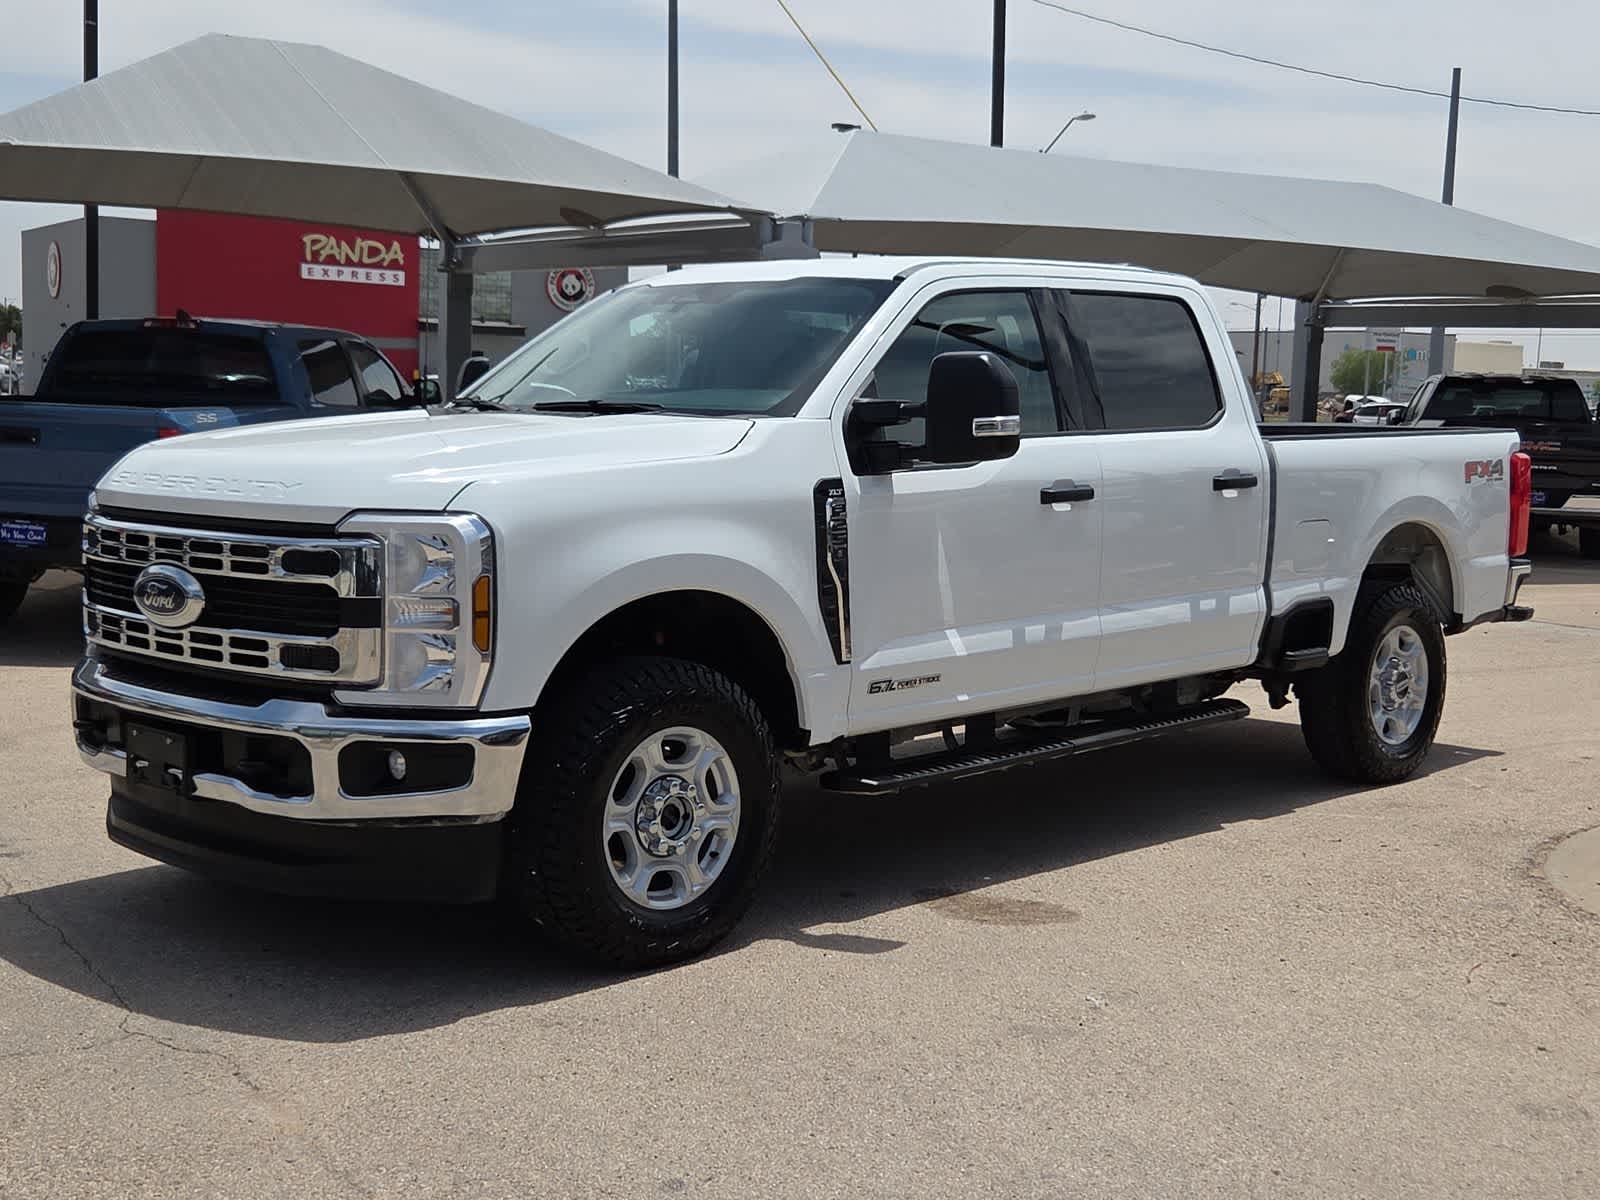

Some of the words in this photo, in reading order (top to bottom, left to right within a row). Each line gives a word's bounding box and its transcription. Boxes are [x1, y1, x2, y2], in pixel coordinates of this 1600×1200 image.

[302, 234, 404, 266] PANDA
[306, 267, 401, 284] EXPRESS
[196, 413, 218, 423] SS
[1464, 459, 1504, 484] FX4
[143, 581, 176, 609] Ford
[868, 679, 896, 694] 6.7L
